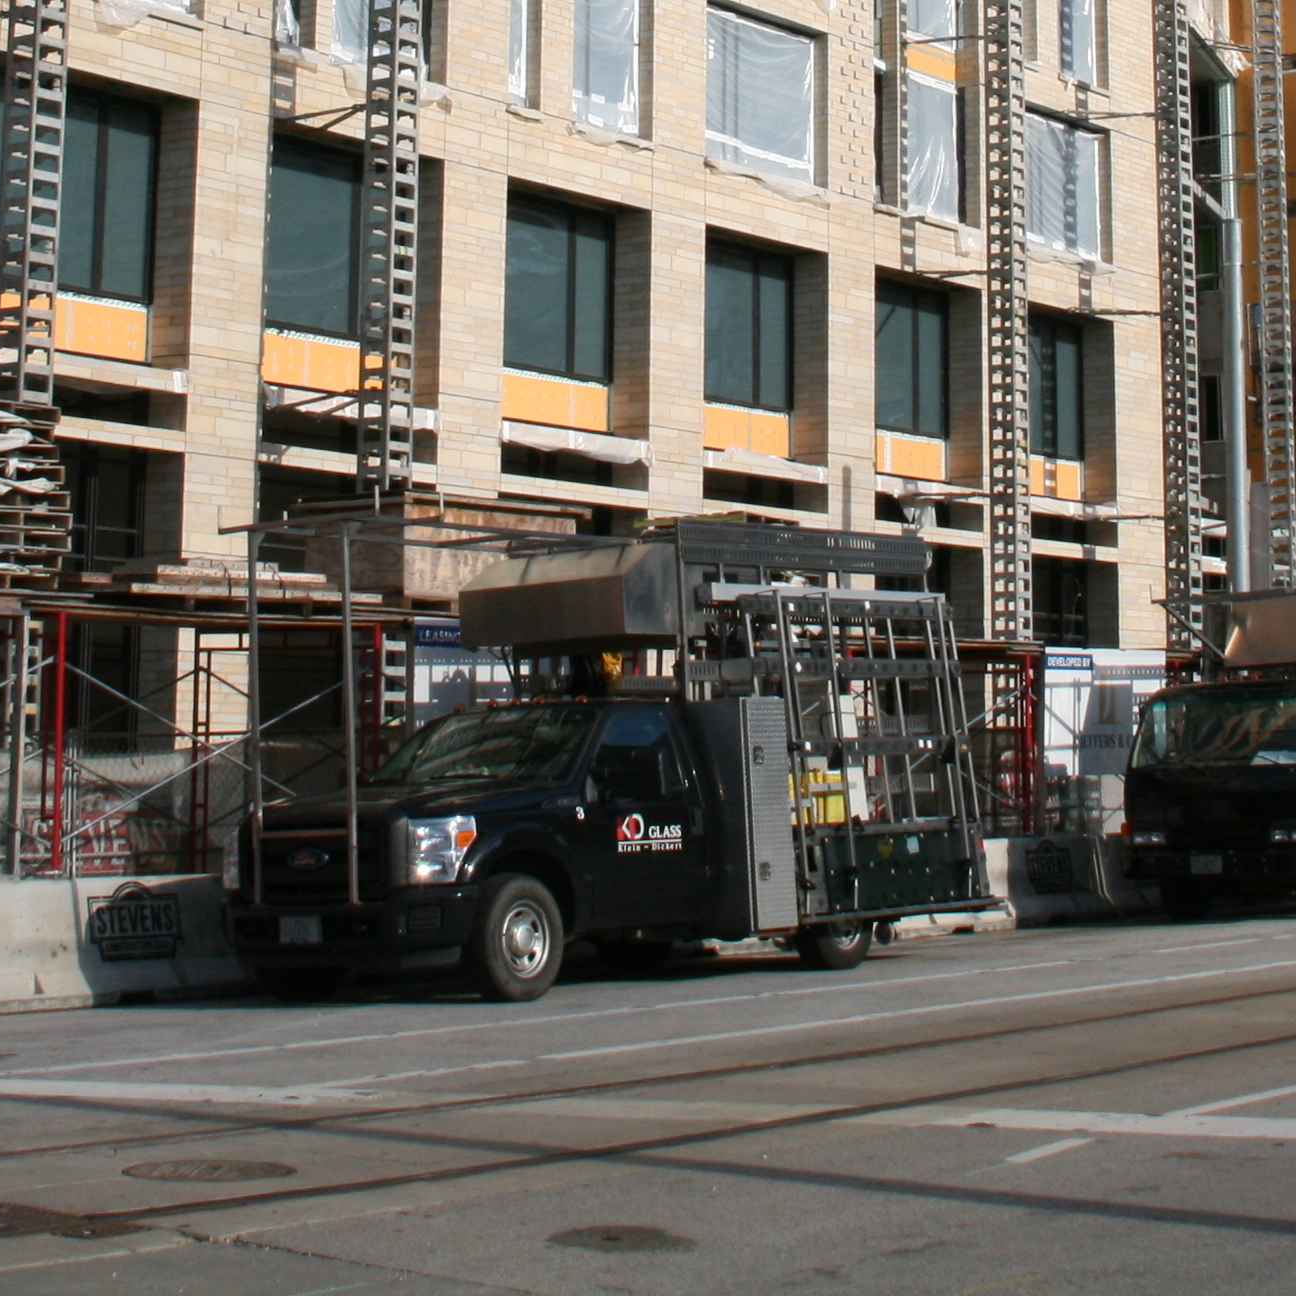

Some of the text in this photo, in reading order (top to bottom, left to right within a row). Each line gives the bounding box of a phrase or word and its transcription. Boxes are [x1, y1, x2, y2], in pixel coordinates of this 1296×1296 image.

[1048, 656, 1091, 667] DEVELOPED BY
[576, 806, 585, 819] 3
[648, 825, 682, 838] GLASS
[96, 904, 174, 935] STEVENS
